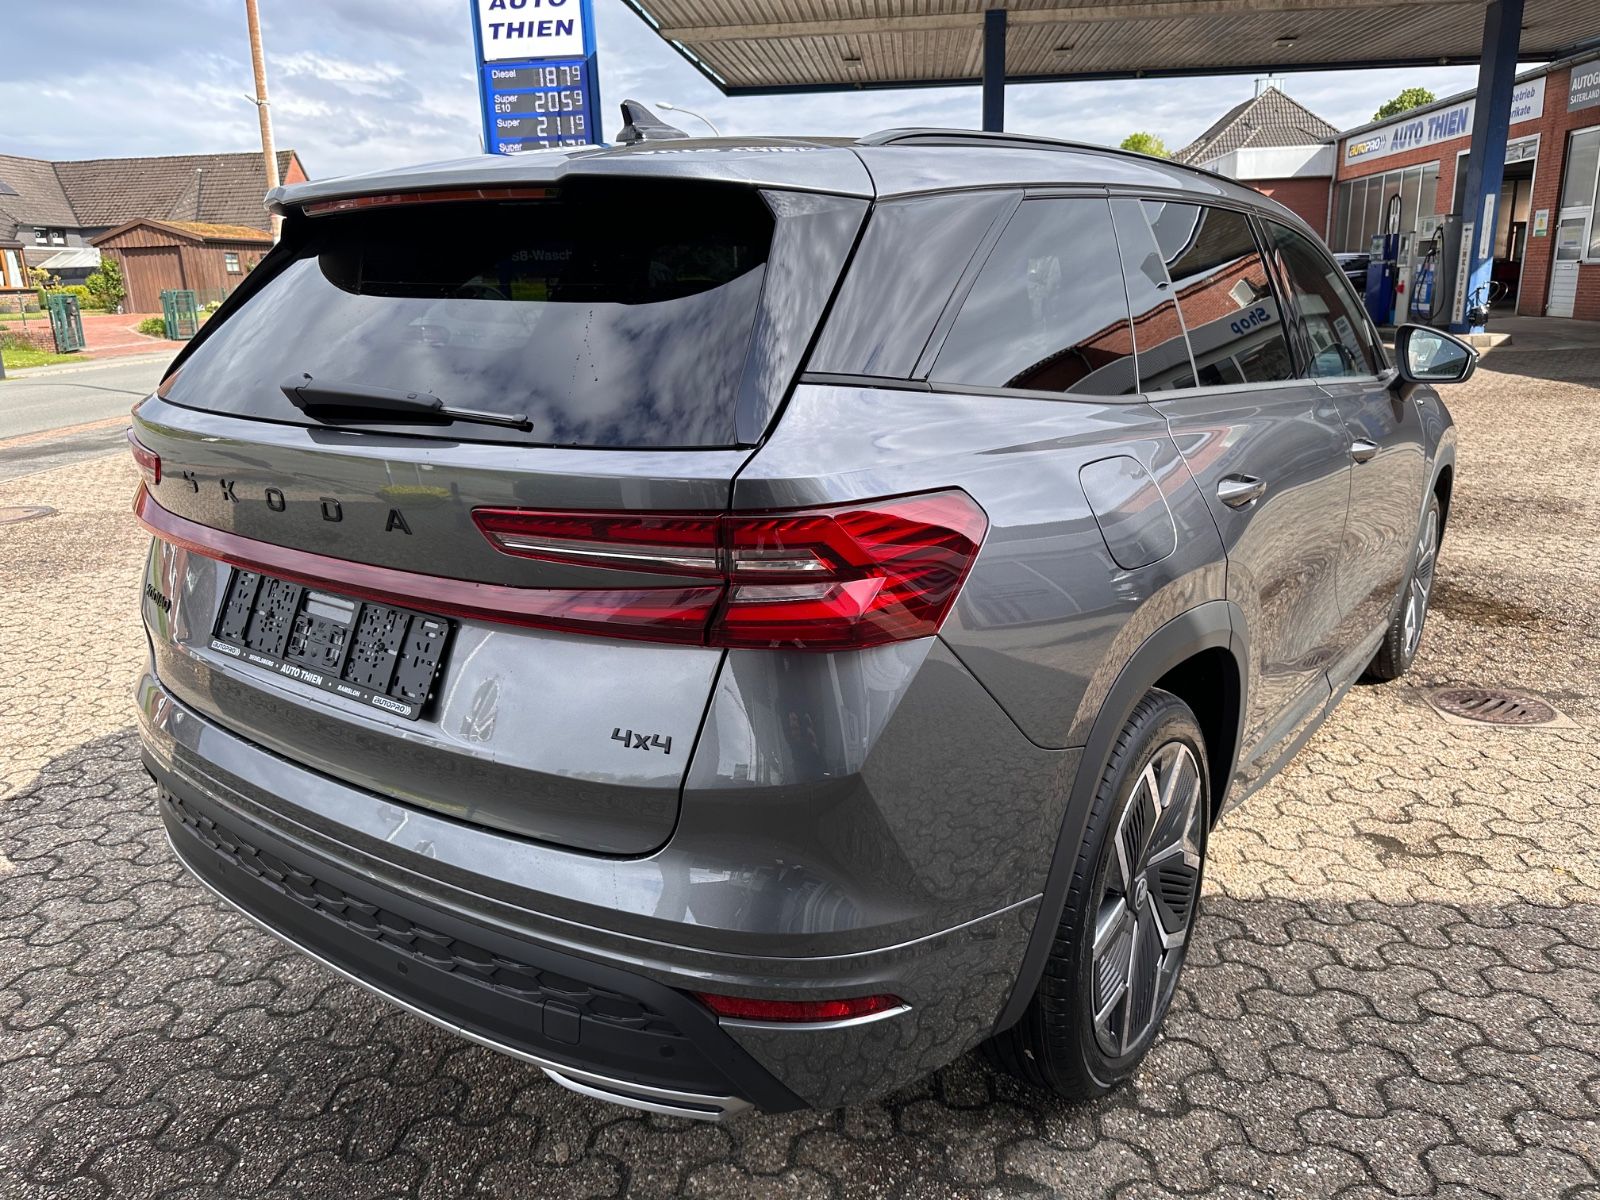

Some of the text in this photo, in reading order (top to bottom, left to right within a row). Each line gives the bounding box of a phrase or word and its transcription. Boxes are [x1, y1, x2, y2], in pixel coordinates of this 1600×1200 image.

[488, 19, 574, 40] THIEN
[491, 69, 517, 79] Diesel
[1571, 71, 1600, 92] AUTOG
[494, 94, 518, 104] Super
[1569, 88, 1600, 105] SATERLAND
[495, 104, 511, 113] E10
[1510, 105, 1531, 119] rikate
[496, 118, 521, 129] Super
[1391, 120, 1424, 151] AUTO
[1427, 106, 1469, 141] THIEN
[498, 142, 523, 153] Super
[280, 664, 300, 677] AUTO
[301, 671, 323, 685] THIEN
[611, 727, 673, 755] 4x4
